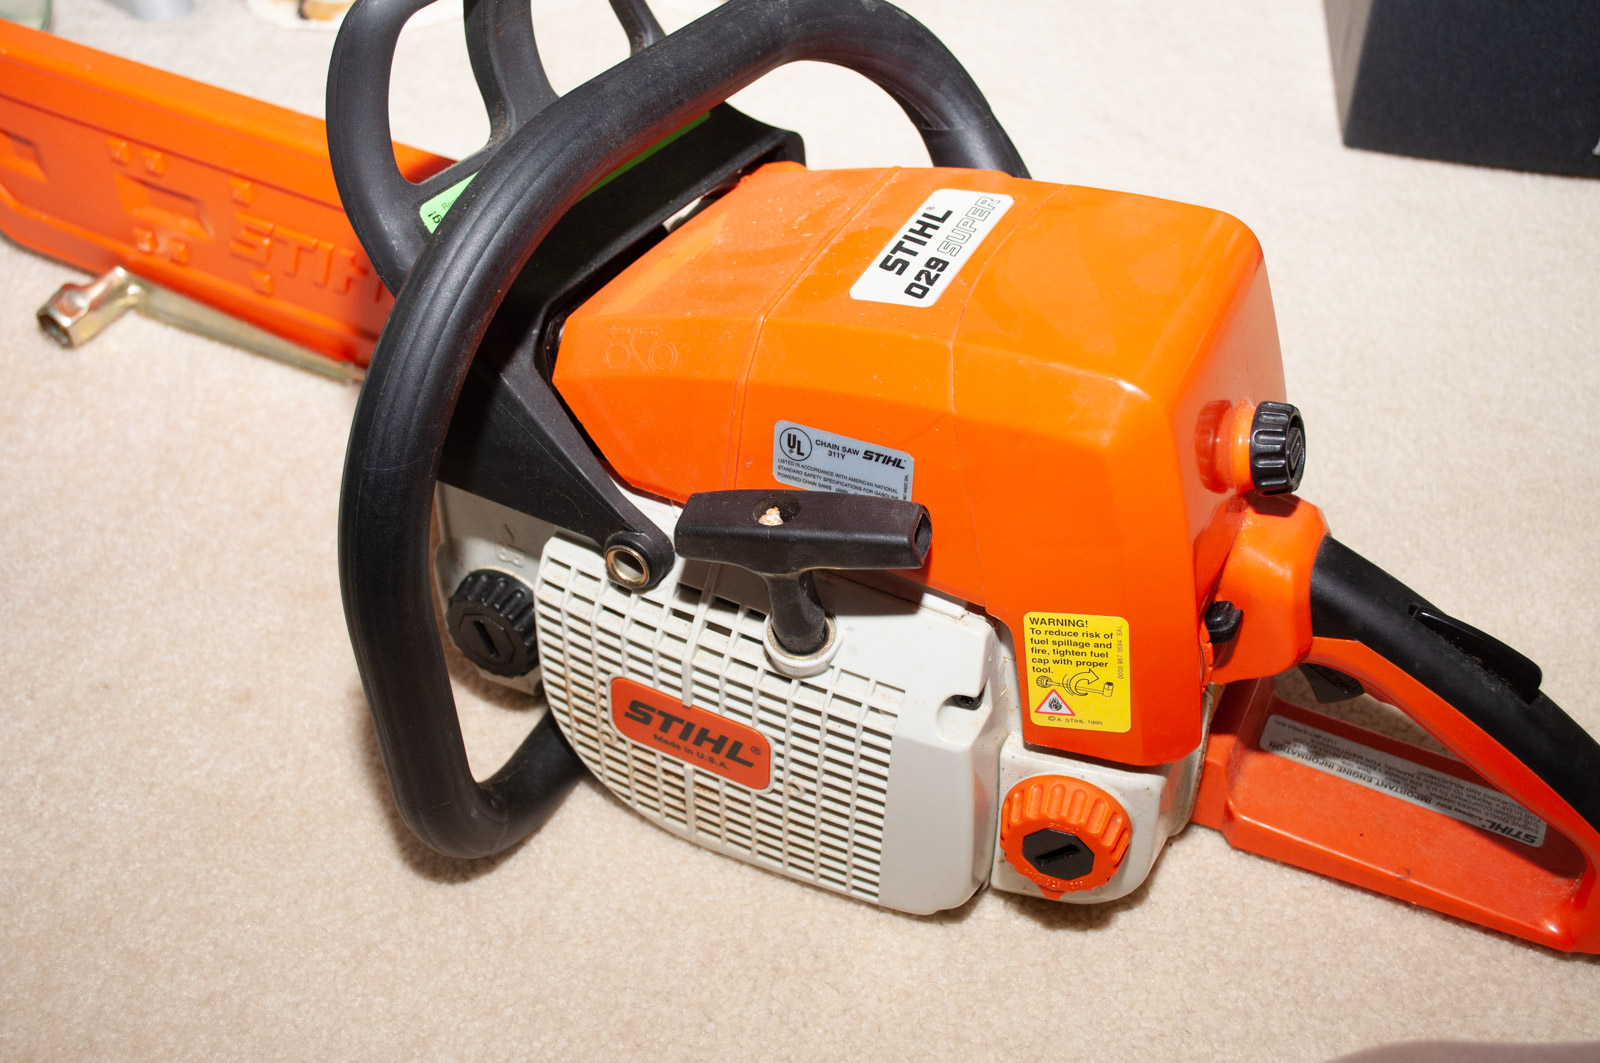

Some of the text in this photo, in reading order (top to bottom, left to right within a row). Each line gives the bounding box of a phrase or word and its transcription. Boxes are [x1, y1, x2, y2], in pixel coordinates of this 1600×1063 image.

[904, 195, 1001, 300] 029 SUPER
[815, 439, 860, 456] CHAIN SAW
[828, 450, 846, 460] 311Y
[778, 458, 794, 466] LISTED
[801, 463, 834, 477] ACCORDANCE
[848, 477, 873, 487] AMERICAN
[875, 484, 898, 494] NATIONAL
[778, 472, 801, 482] POWERED
[778, 465, 803, 475] STANDARD
[804, 472, 822, 480] SAFETY
[823, 477, 862, 491] SPECIFICATIONS
[1029, 617, 1088, 628] WARNING!
[1045, 629, 1079, 637] reduce
[1031, 647, 1050, 656] fire,
[1053, 648, 1087, 657] tighten
[1052, 639, 1091, 649] spillage
[1076, 660, 1108, 668] proper
[653, 733, 729, 770] Made in U.S.A.
[1267, 740, 1334, 770] INFORMATION
[1336, 765, 1372, 783] ENGINE
[1374, 778, 1431, 804] IMPORTANT
